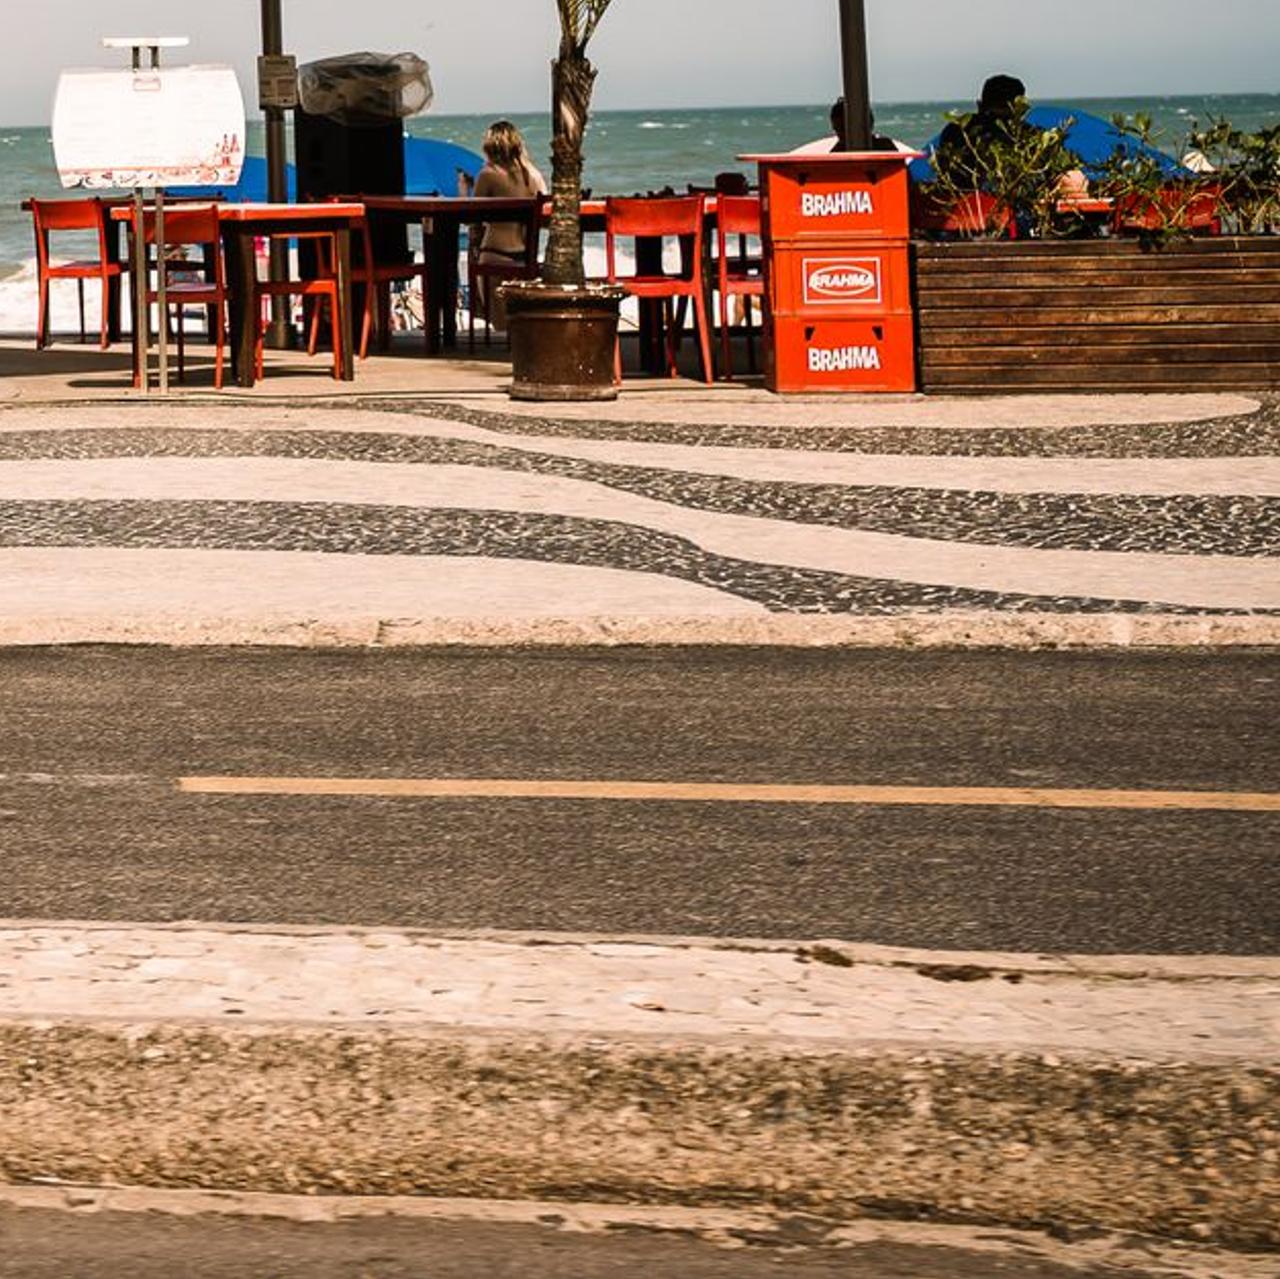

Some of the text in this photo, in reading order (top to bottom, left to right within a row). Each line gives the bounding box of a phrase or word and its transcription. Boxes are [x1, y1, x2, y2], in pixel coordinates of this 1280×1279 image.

[801, 191, 873, 217] BRAHMA
[808, 273, 876, 289] BRAHMA
[807, 345, 881, 372] BRAHMA
